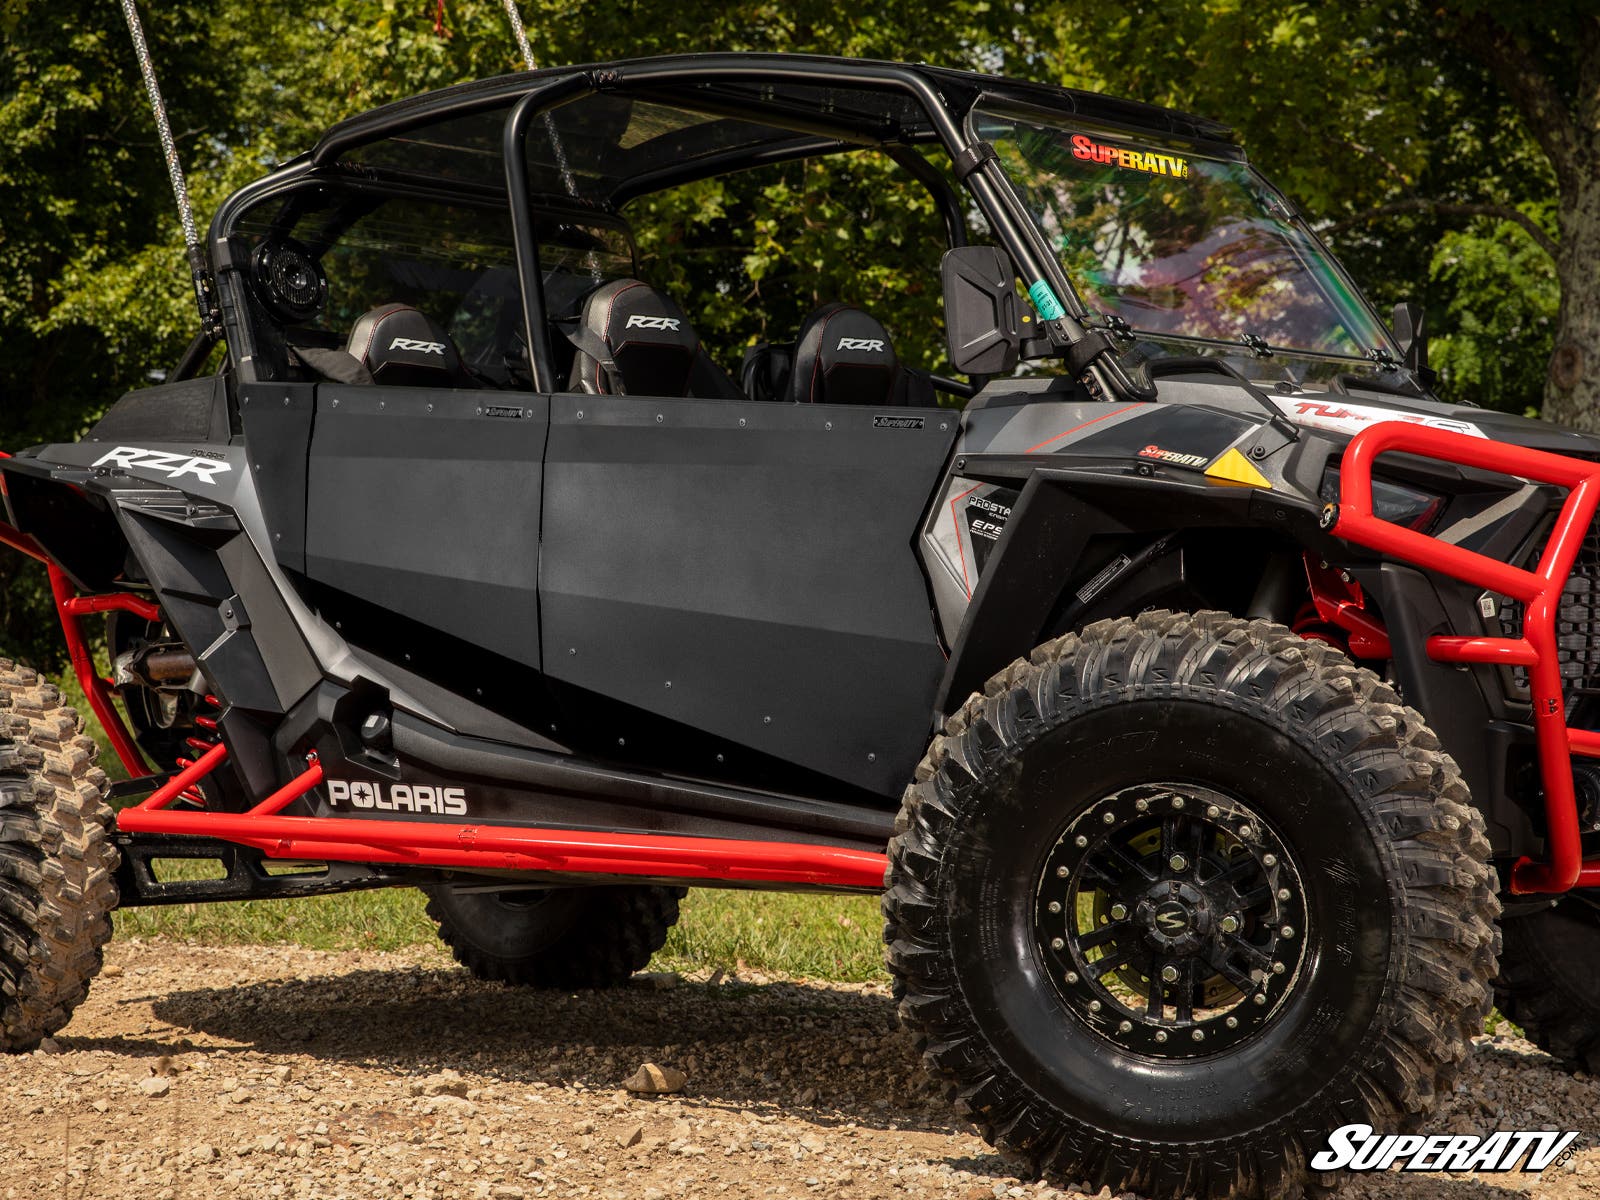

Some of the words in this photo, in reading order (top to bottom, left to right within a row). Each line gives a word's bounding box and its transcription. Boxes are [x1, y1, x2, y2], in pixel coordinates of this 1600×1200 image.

[626, 315, 680, 331] RZR
[388, 337, 447, 355] RZR
[837, 337, 884, 352] RZR
[190, 449, 226, 460] POLARIS
[1138, 445, 1209, 467] SUPERATV
[91, 446, 232, 485] RZR
[972, 519, 1003, 535] EPS
[327, 780, 467, 816] POLARIS
